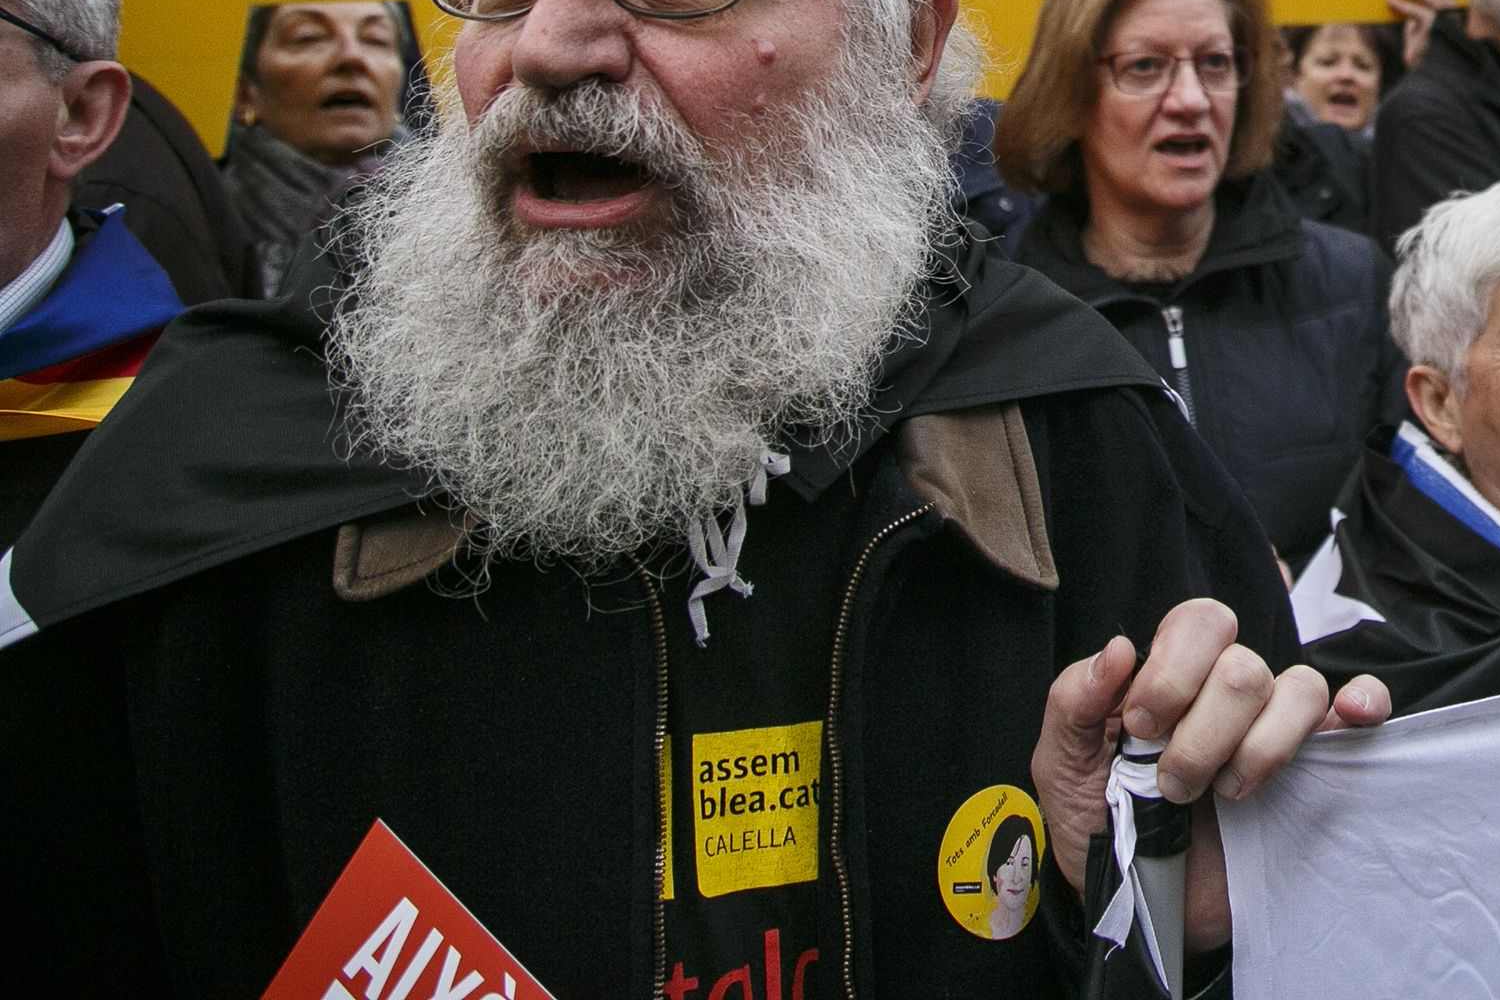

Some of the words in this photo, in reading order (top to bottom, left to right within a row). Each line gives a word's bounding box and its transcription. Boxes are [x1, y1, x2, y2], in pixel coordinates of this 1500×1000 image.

[700, 750, 801, 784] assem
[700, 778, 821, 820] blea.cat
[705, 826, 797, 857] CALELLA
[945, 848, 964, 868] Tots
[965, 828, 981, 849] amb
[981, 792, 1008, 829] Forcadell
